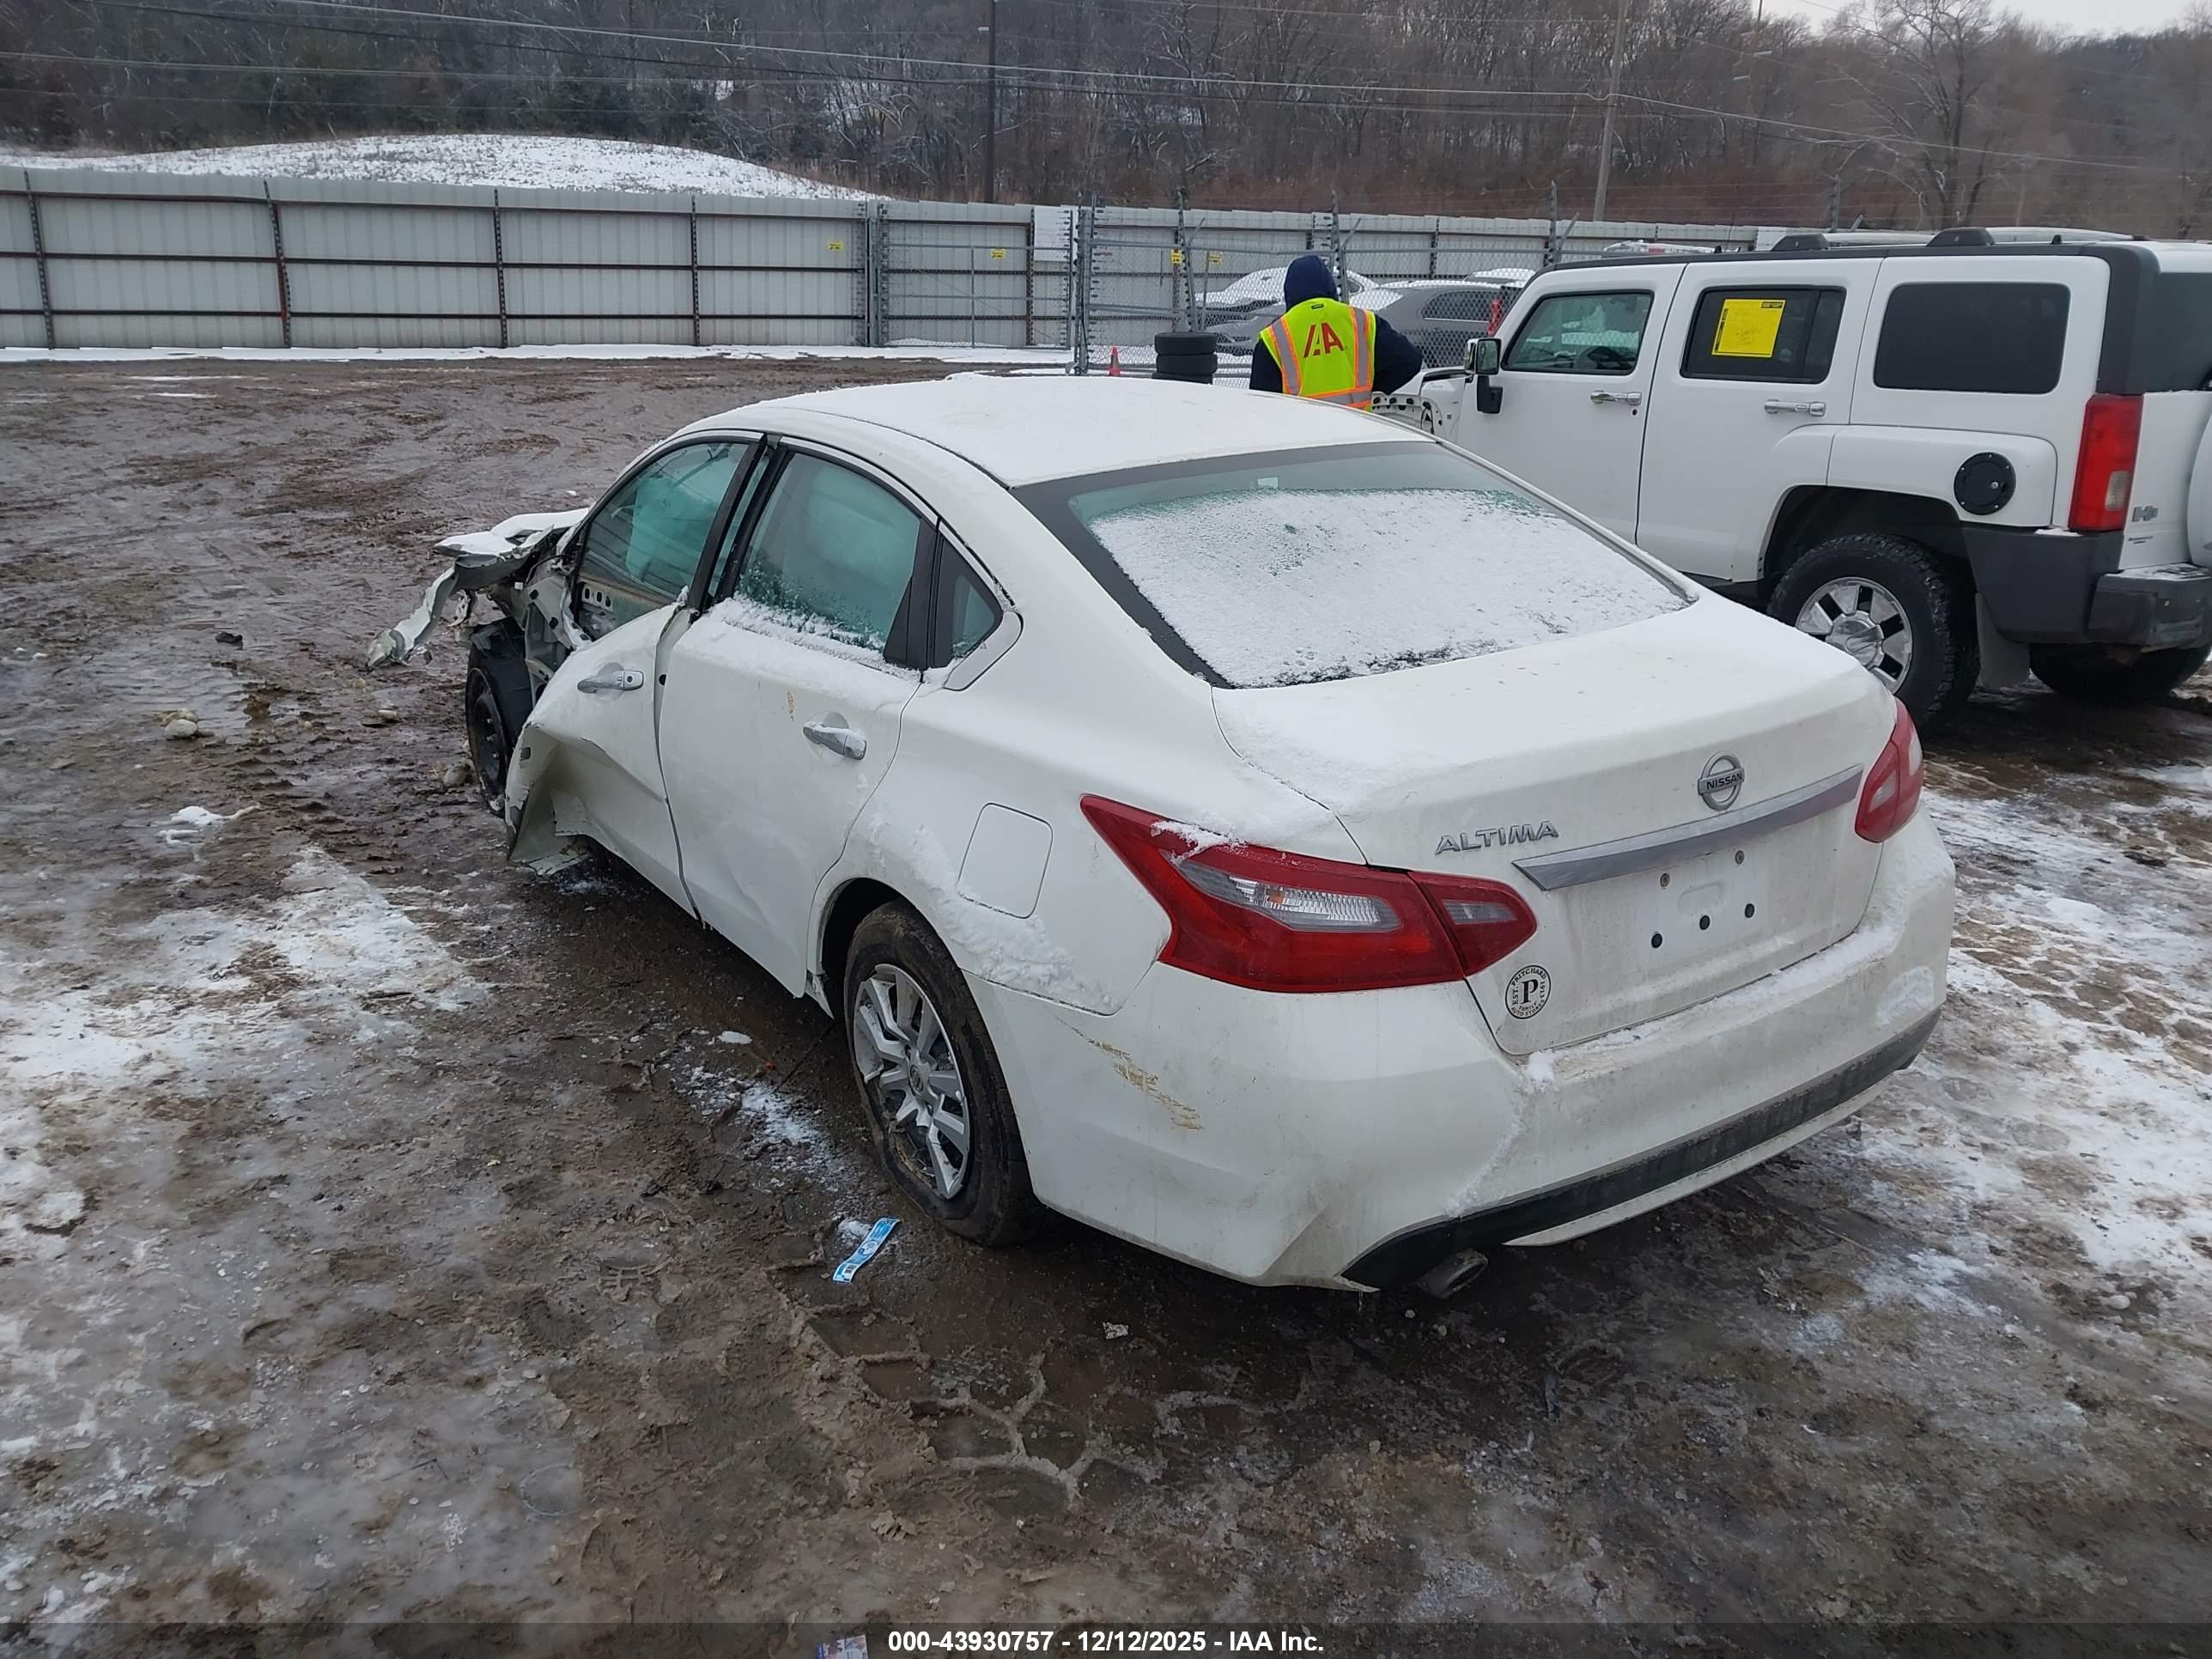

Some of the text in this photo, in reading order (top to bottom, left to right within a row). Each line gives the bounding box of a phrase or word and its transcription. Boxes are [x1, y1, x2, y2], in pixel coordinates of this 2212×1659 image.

[1706, 773, 1742, 790] NISSAN
[1435, 820, 1559, 855] ALTIMA
[1511, 968, 1547, 986] PRITCHARD
[1520, 979, 1539, 1004] P
[1519, 1001, 1537, 1011] FAMILY
